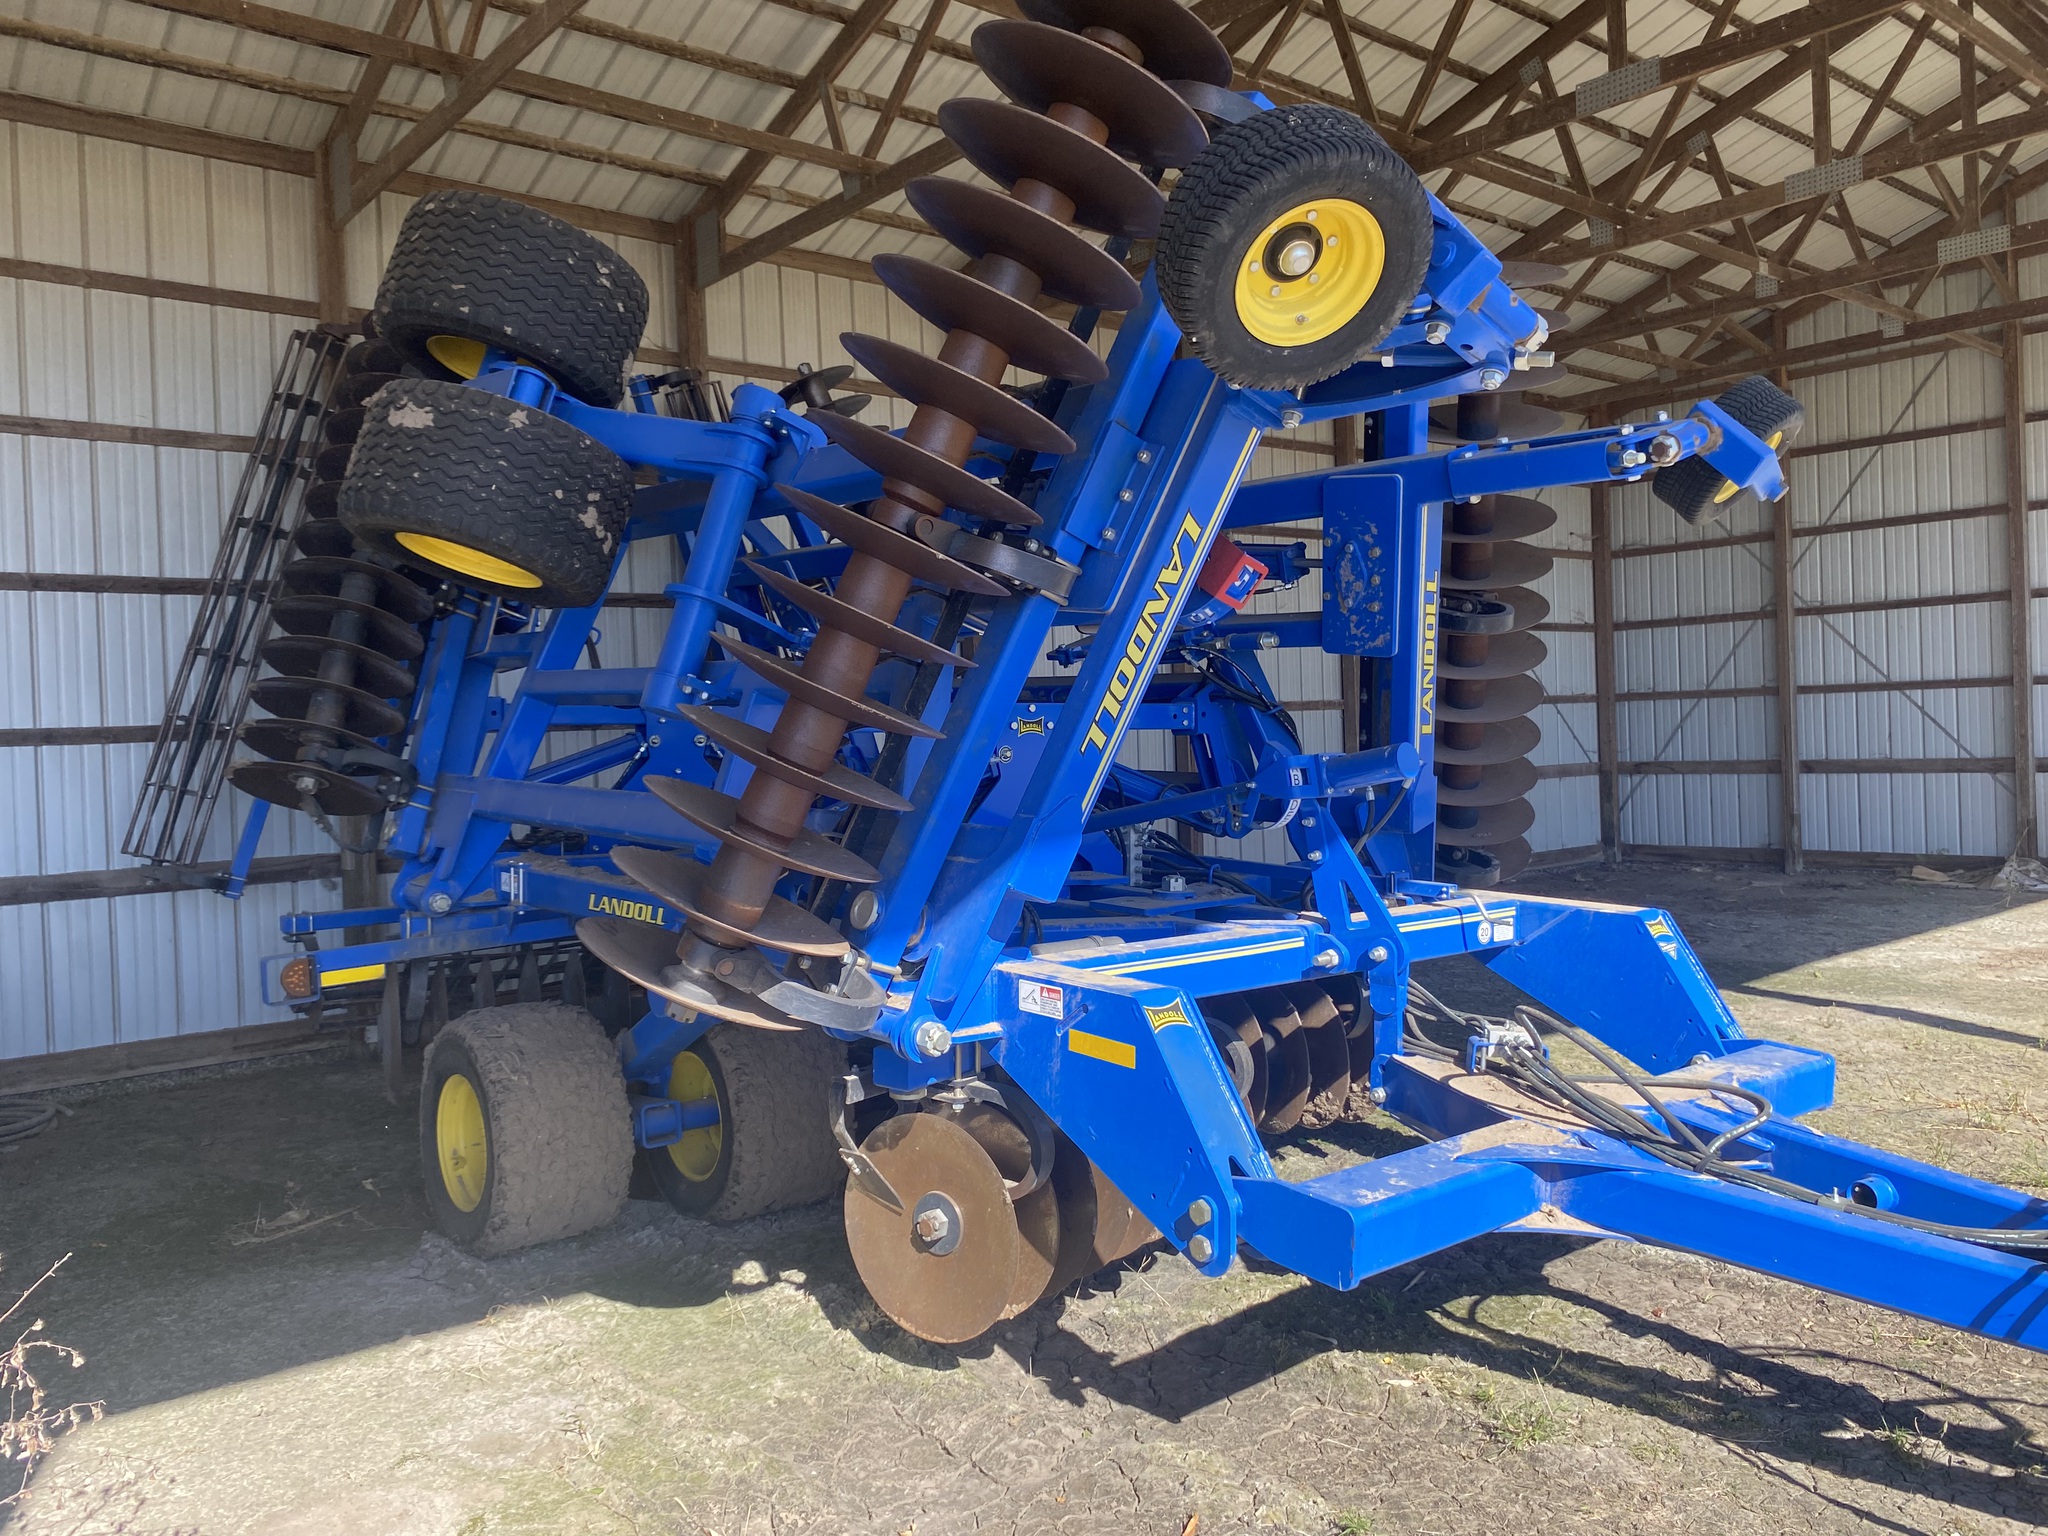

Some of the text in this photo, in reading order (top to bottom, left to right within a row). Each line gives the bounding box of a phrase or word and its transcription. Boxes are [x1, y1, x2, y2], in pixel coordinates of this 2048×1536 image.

[1079, 508, 1203, 756] LANDOLL
[1420, 570, 1438, 735] LANDOLL
[588, 893, 669, 926] LANDOLL
[1480, 927, 1489, 937] 20
[1147, 1010, 1184, 1027] LANDOLL
